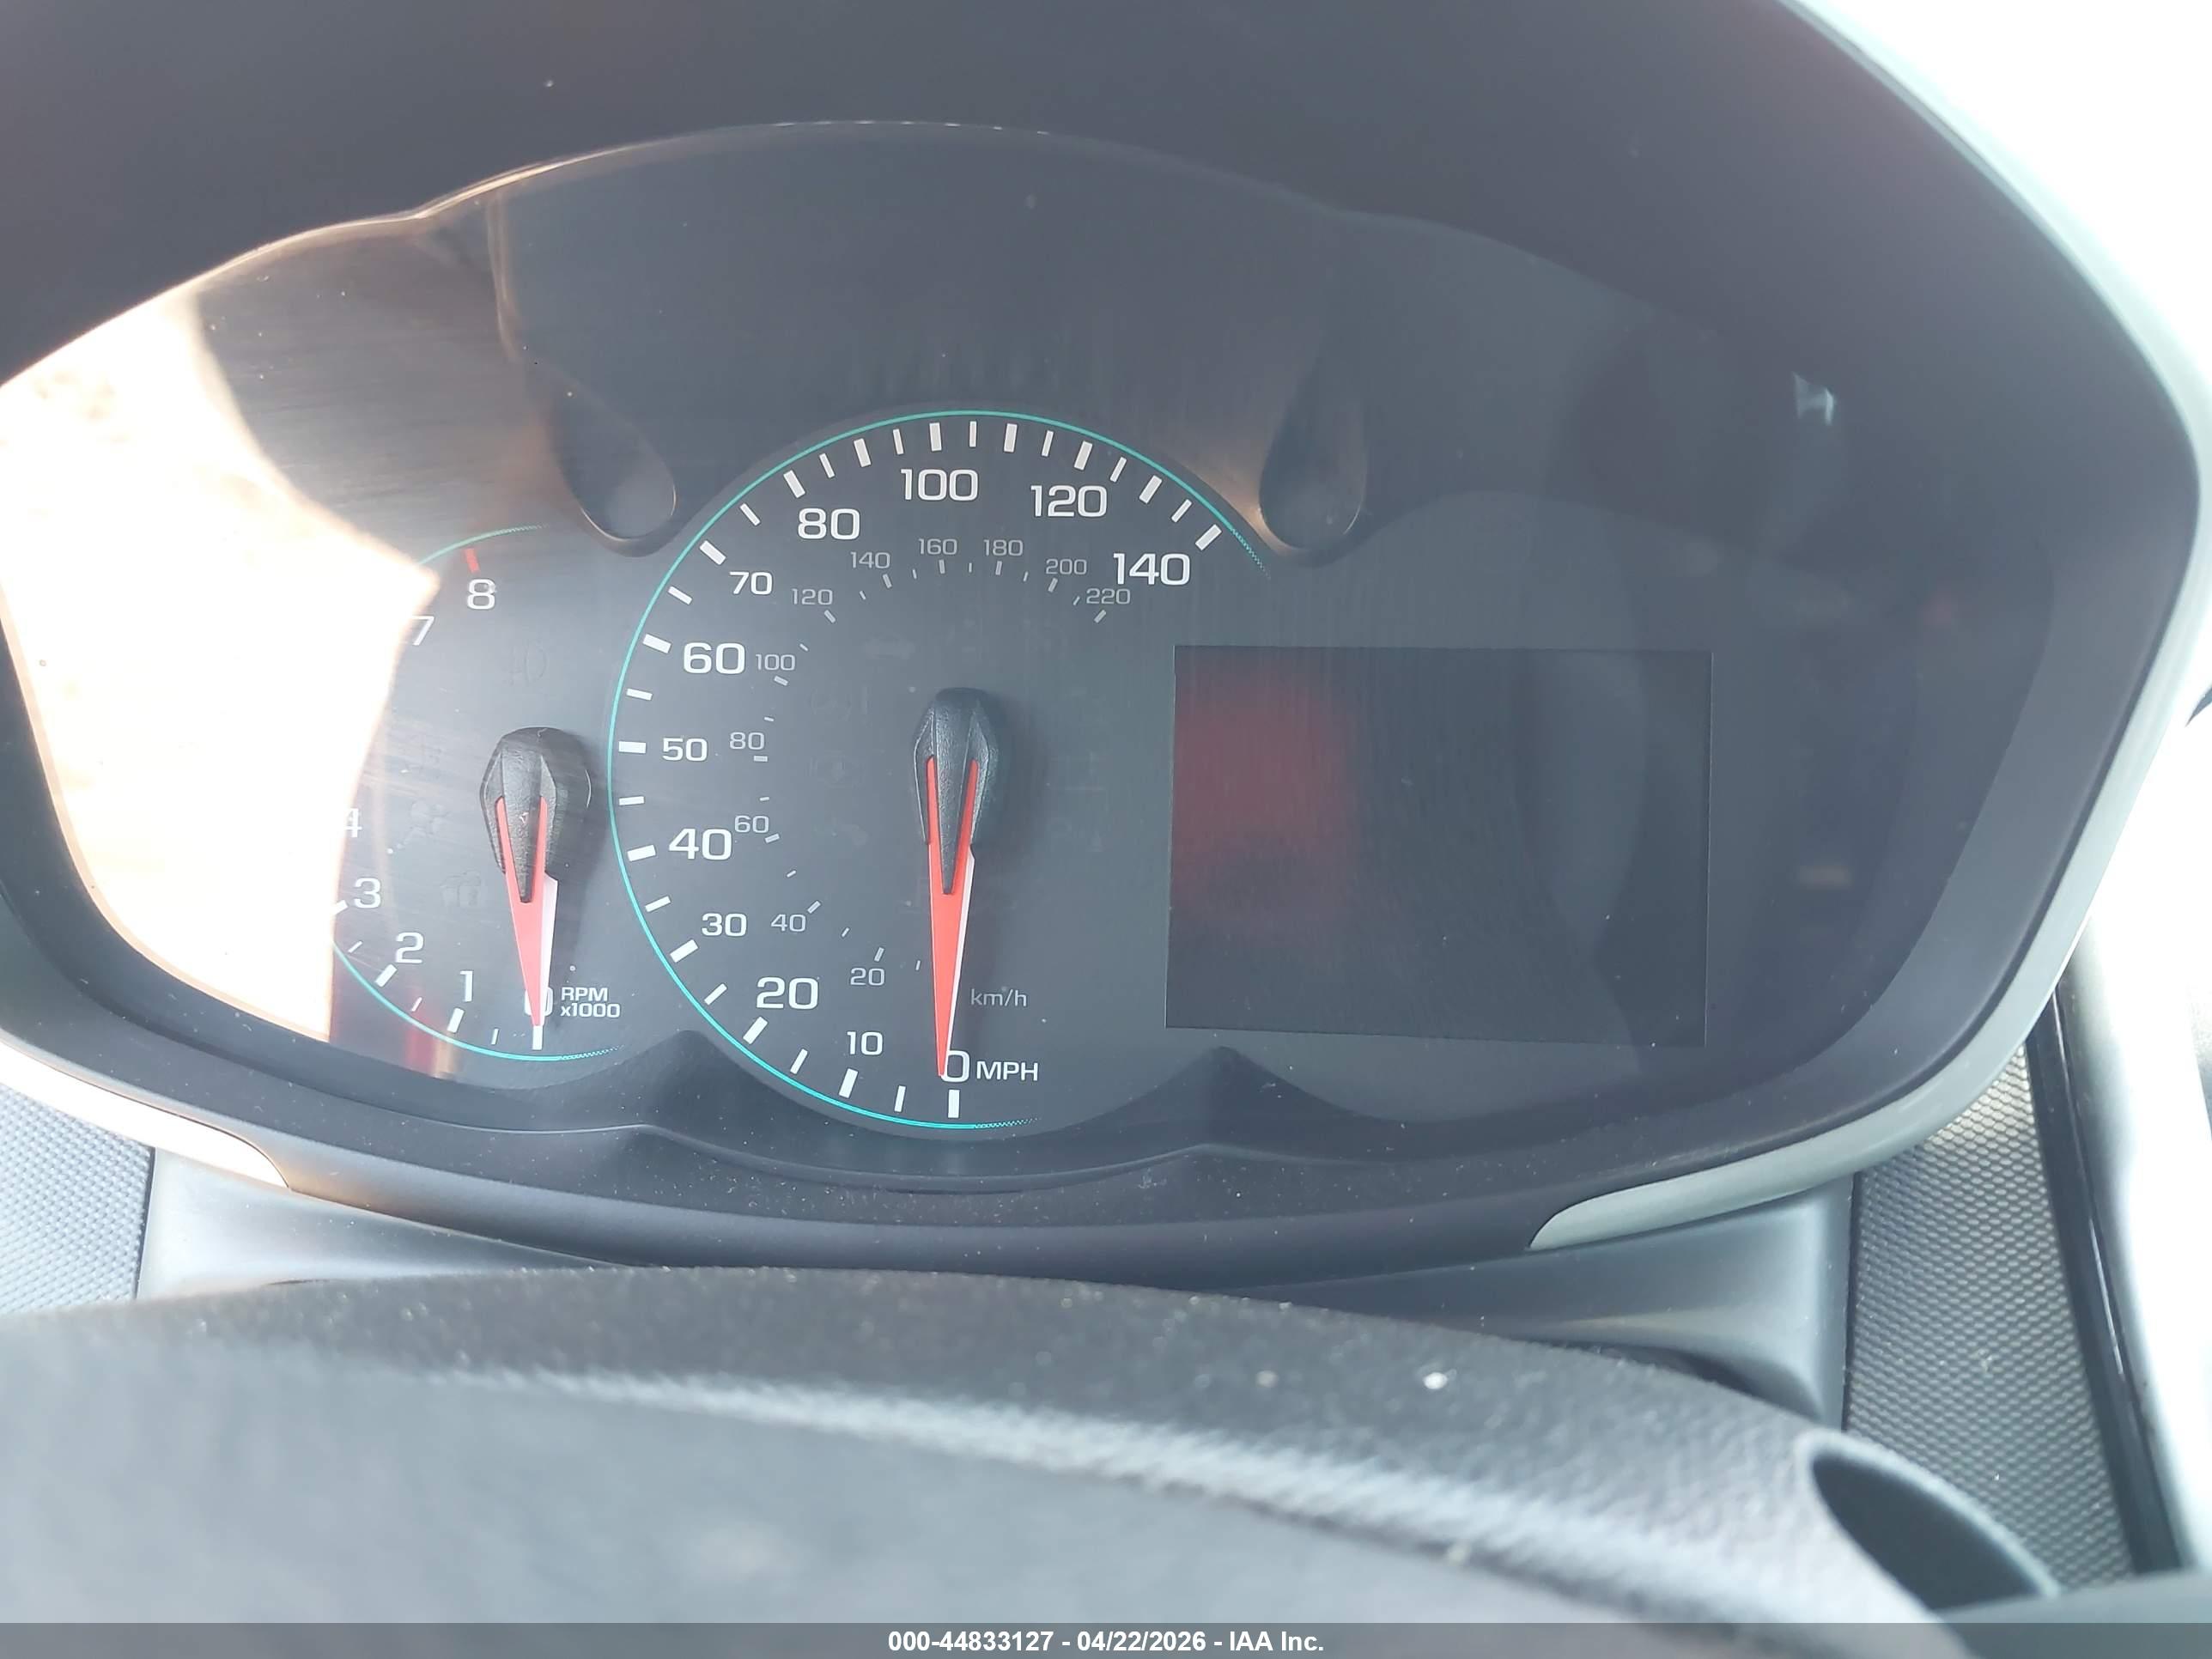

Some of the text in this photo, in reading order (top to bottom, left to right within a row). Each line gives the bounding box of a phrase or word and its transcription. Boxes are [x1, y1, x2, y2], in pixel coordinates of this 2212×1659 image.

[900, 468, 979, 501] 100
[1030, 484, 1109, 518] 120
[797, 507, 860, 540] 80
[918, 538, 957, 556] 160
[983, 539, 1024, 557] 180
[850, 550, 890, 569] 140
[1045, 558, 1088, 576] 200
[1114, 552, 1191, 586] 140
[466, 578, 496, 610] 8
[729, 570, 773, 595] 70
[791, 587, 833, 606] 120
[1086, 587, 1131, 605] 220
[683, 642, 745, 674] 60
[755, 653, 796, 672] 100
[662, 738, 708, 762] 50
[729, 732, 765, 751] 80
[734, 815, 769, 834] 60
[668, 828, 733, 860] 40
[353, 878, 381, 908] 3
[701, 913, 747, 937] 30
[770, 914, 806, 933] 40
[395, 932, 424, 964] 2
[459, 970, 473, 1002] 1
[850, 968, 885, 987] 20
[561, 987, 608, 1001] RPM
[757, 976, 818, 1010] 20
[970, 987, 1028, 1007] km/h
[560, 1003, 621, 1018] x1000
[847, 1031, 883, 1055] 10
[941, 1049, 1038, 1083] 0 MPH
